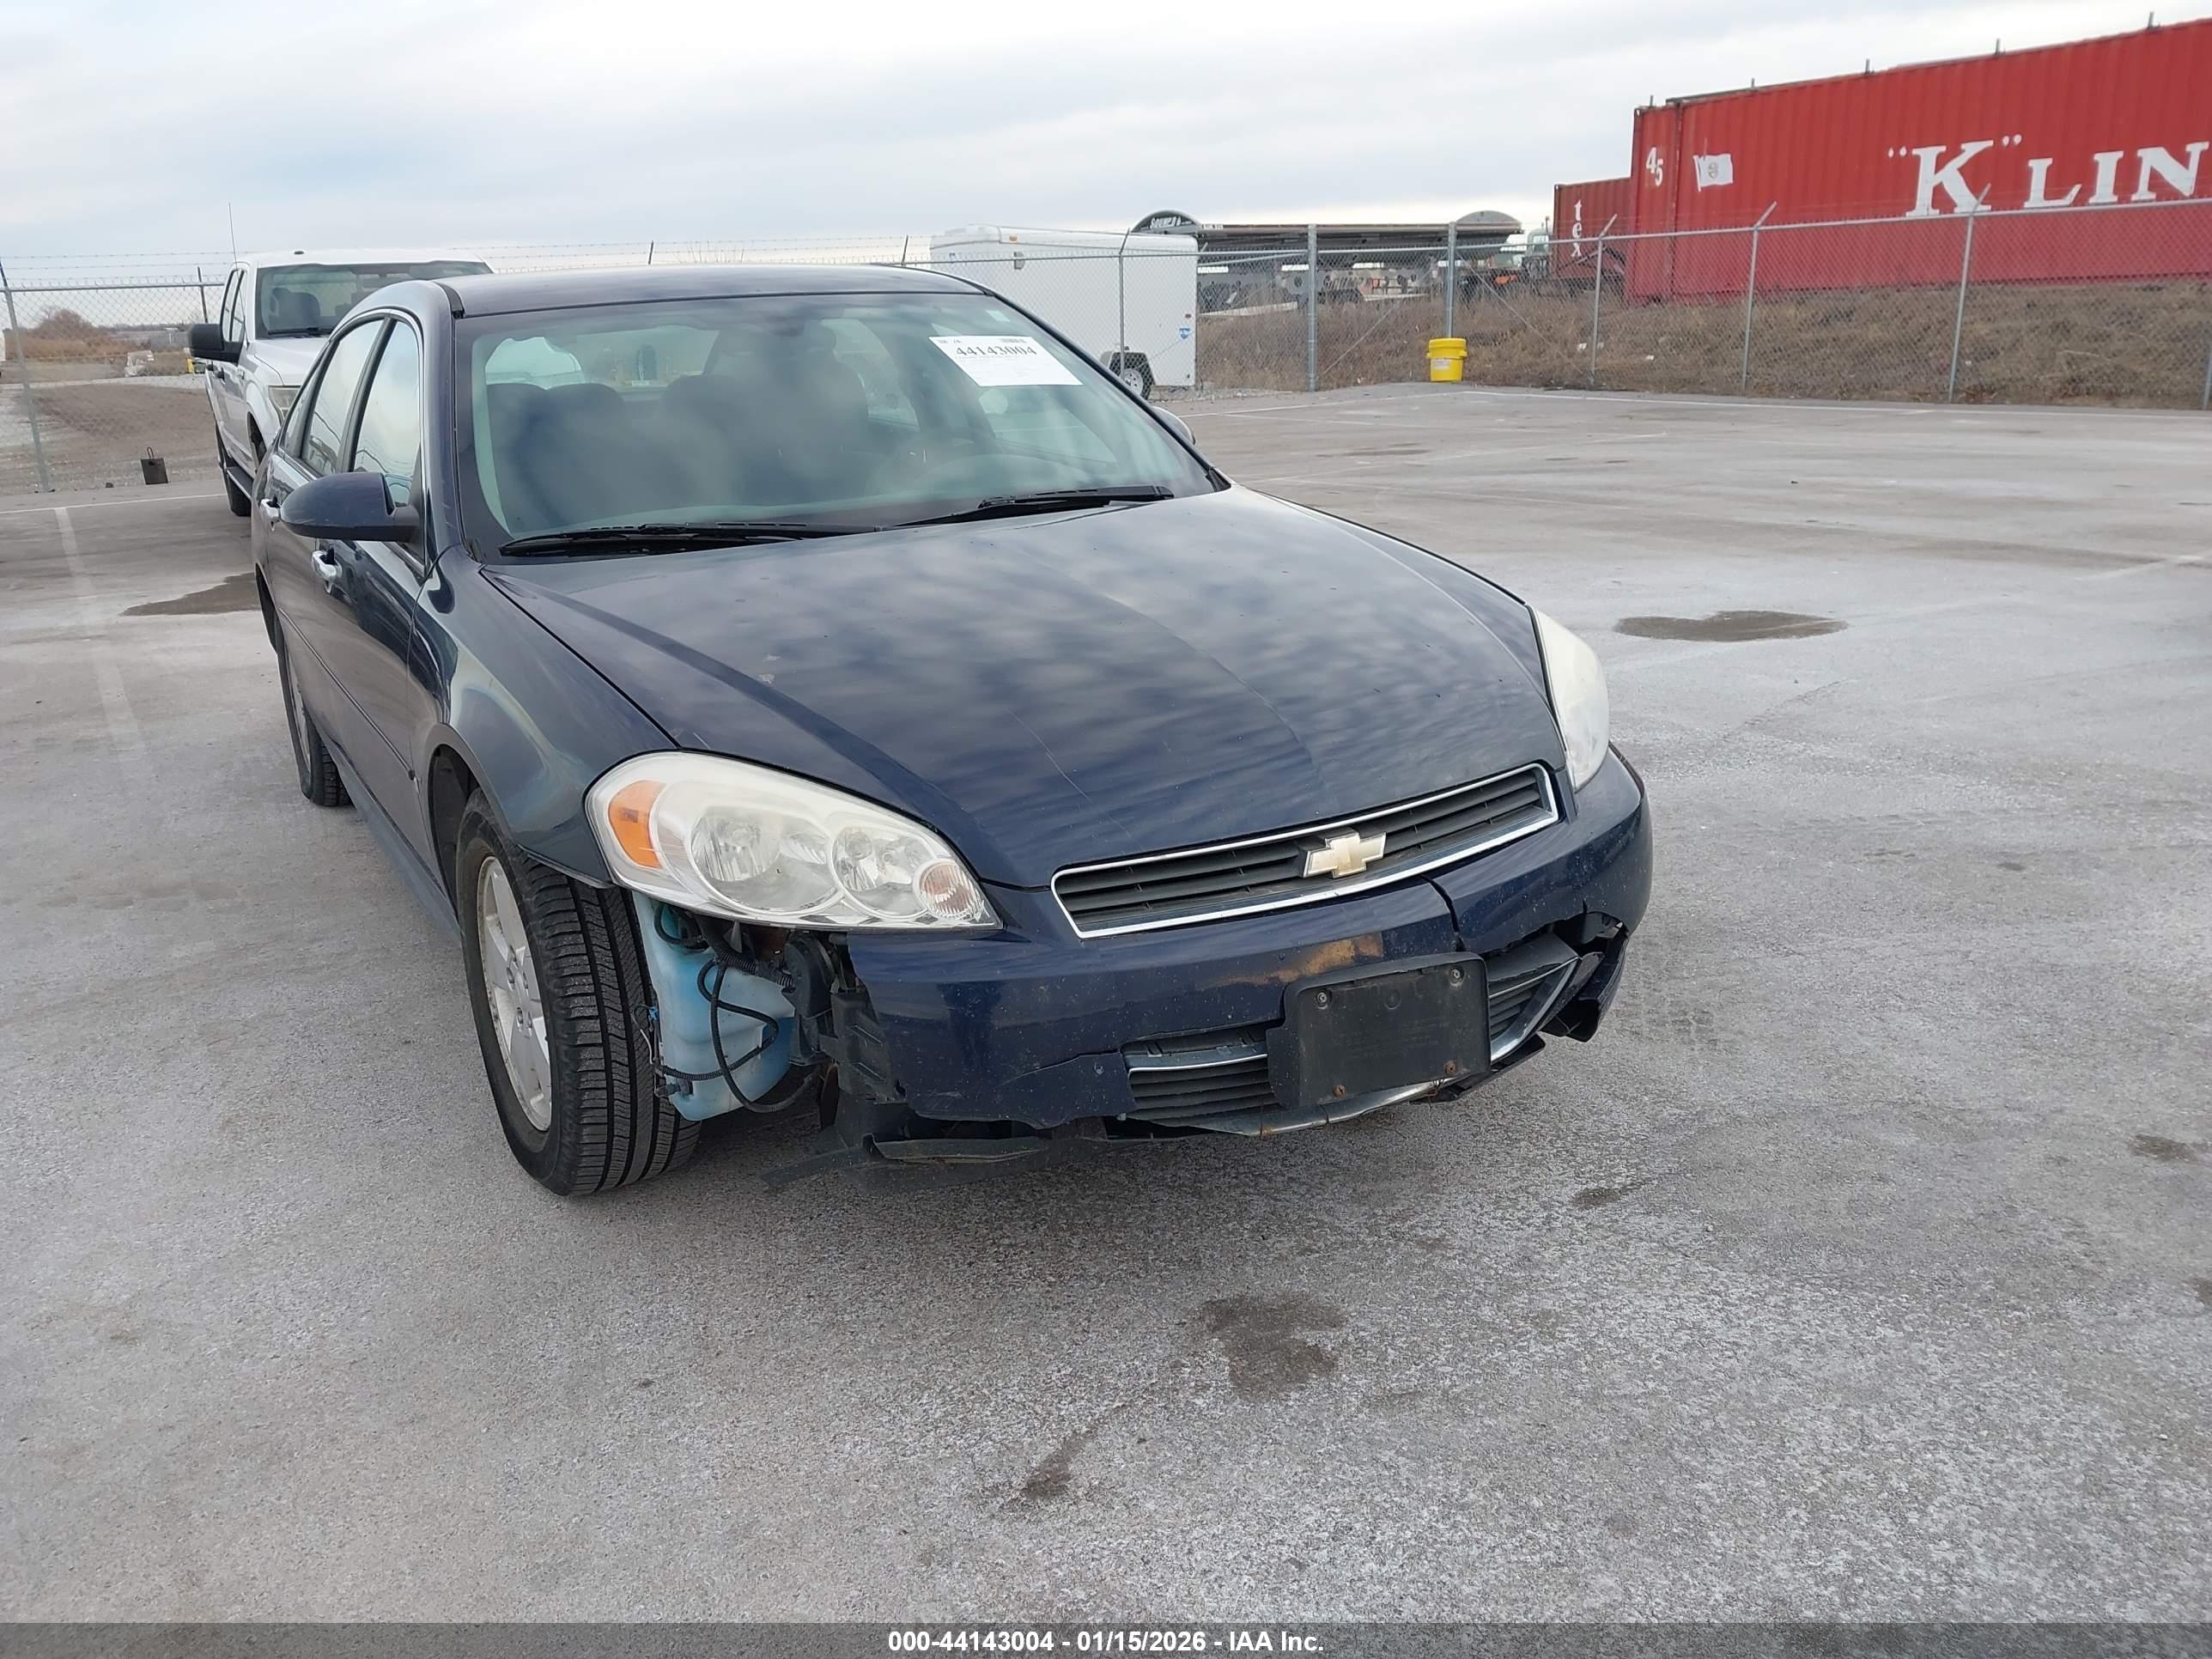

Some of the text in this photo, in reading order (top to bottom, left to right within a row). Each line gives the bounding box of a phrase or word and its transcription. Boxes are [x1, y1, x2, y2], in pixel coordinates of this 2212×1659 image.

[1645, 146, 1664, 187] 45
[1571, 198, 1583, 258] tex
[956, 345, 1037, 356] 44143004
